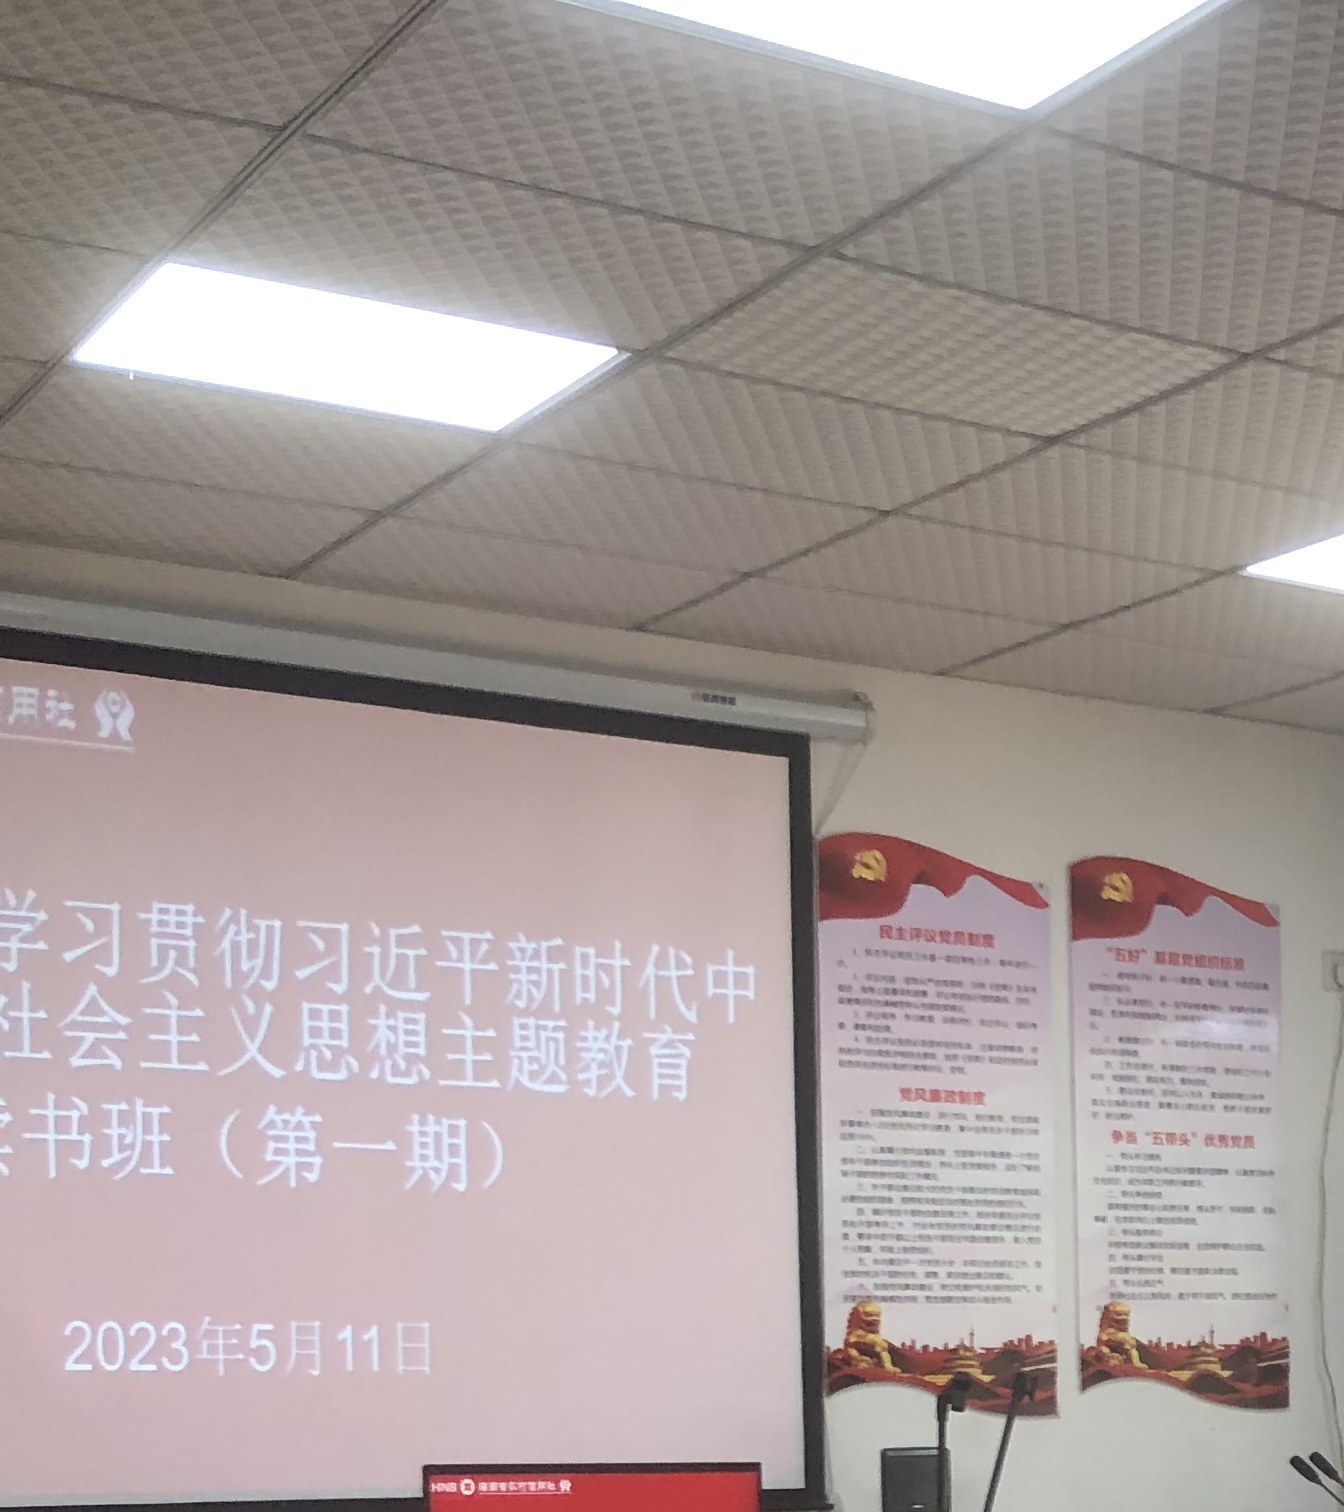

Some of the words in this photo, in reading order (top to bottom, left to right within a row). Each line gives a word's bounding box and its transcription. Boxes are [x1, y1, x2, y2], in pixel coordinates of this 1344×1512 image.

[0, 685, 78, 730] 用社
[0, 887, 757, 1026] 学习贯彻习近平新时代中
[879, 924, 995, 948] 民主评议党员制度
[0, 979, 696, 1102] 社会主义思想主题教育
[0, 1090, 504, 1193] 书班（第一期）
[63, 1315, 432, 1377] 2023年5月11日
